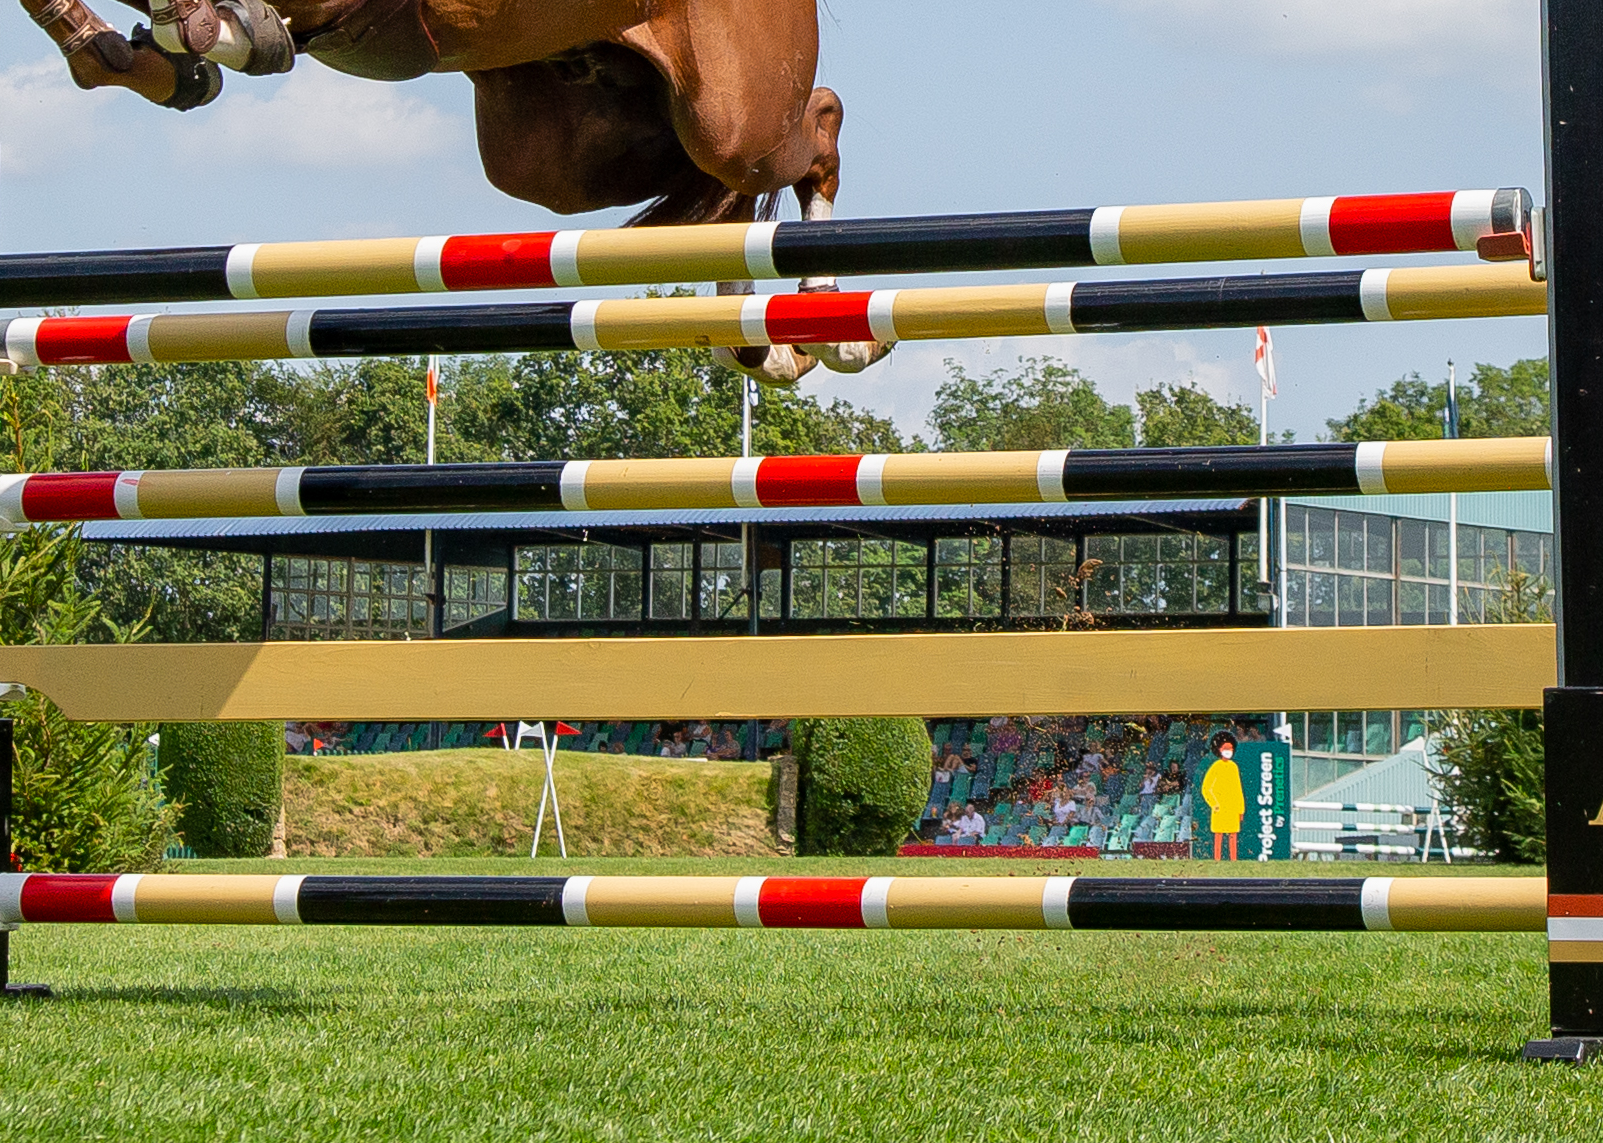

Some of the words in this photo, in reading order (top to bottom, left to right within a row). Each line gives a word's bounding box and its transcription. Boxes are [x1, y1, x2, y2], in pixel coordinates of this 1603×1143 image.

[1258, 752, 1273, 805] Screen
[1273, 757, 1285, 815] Prenetics
[1275, 815, 1285, 827] by
